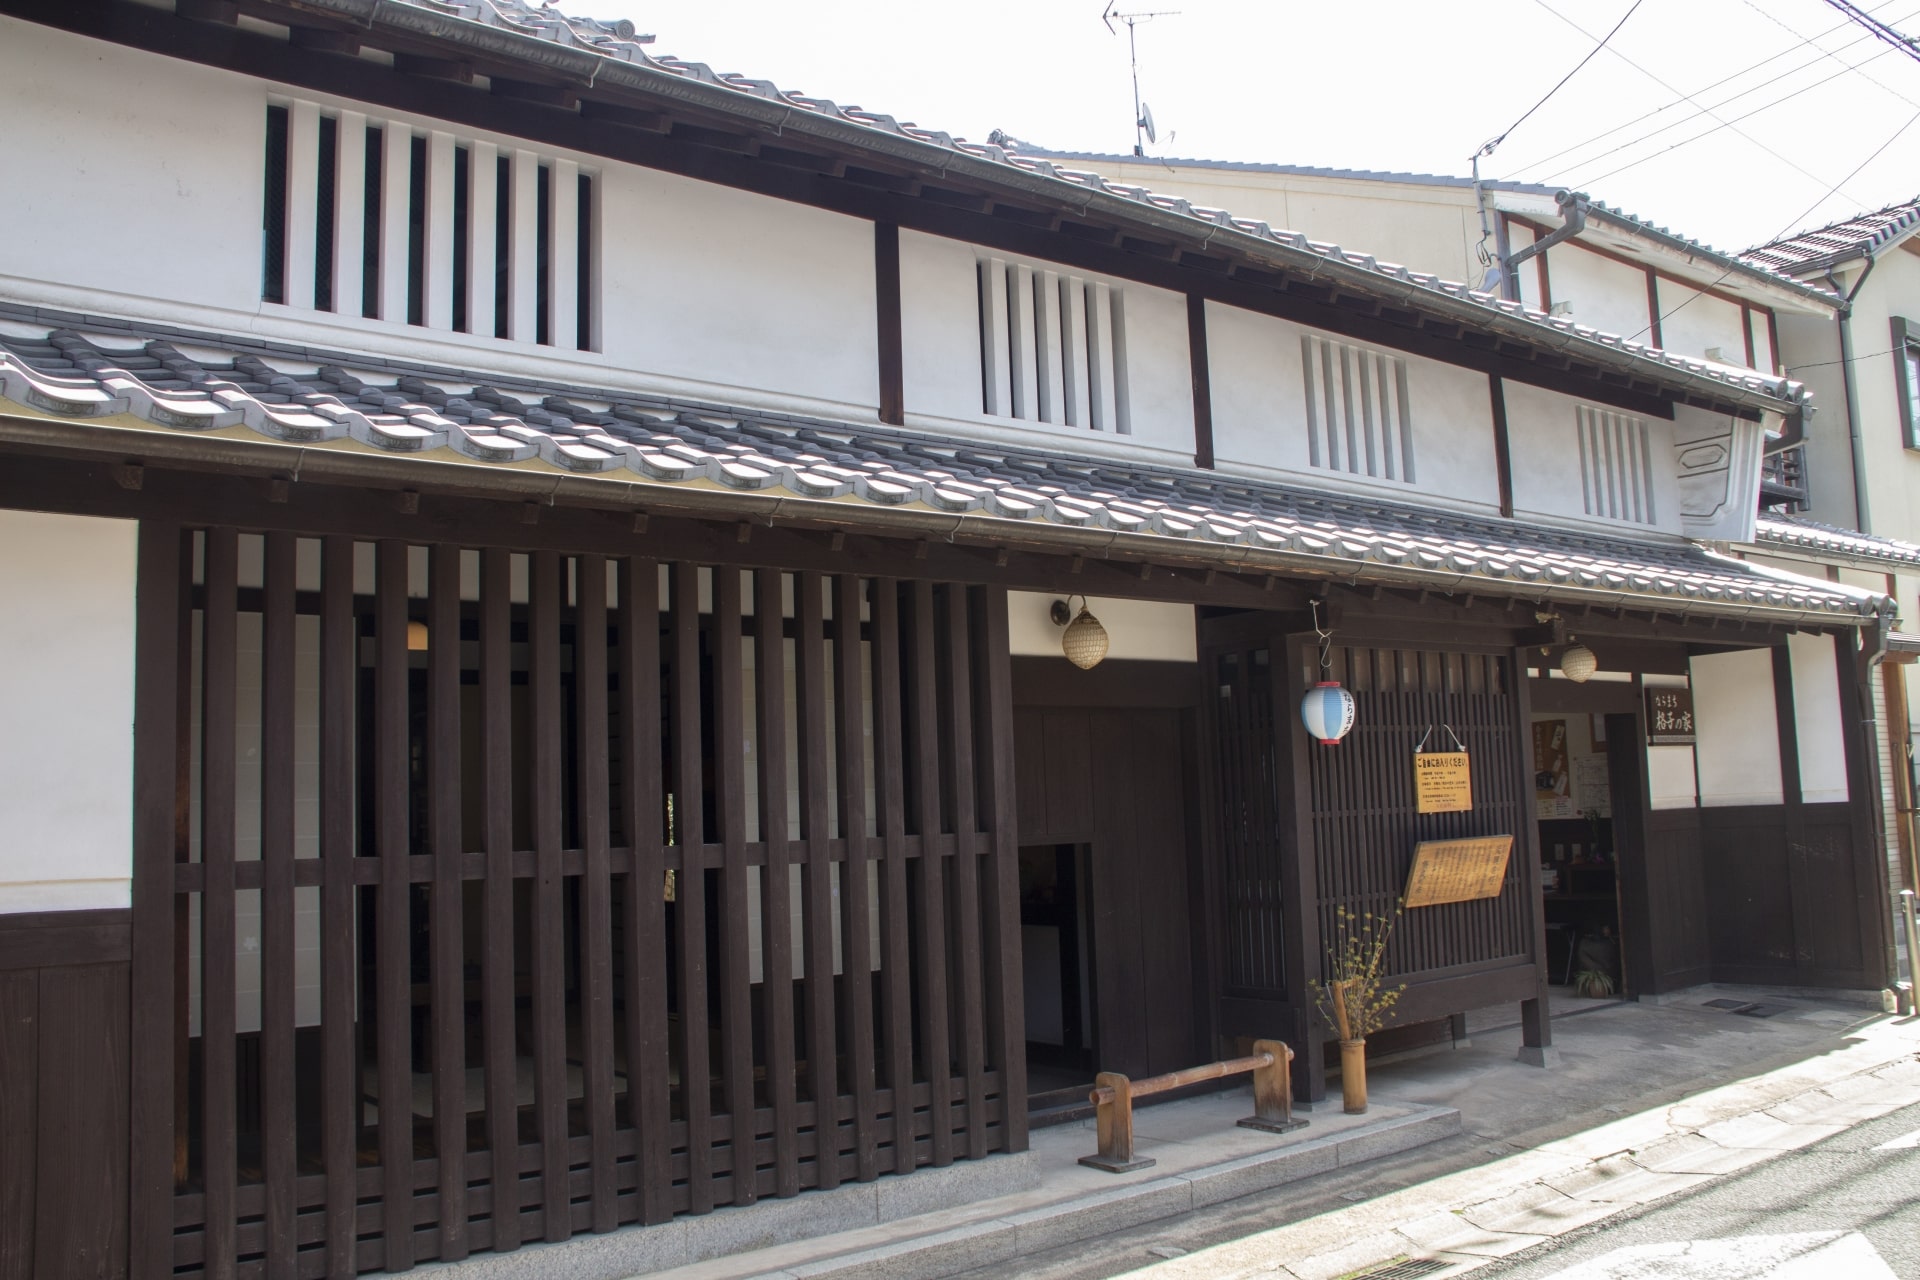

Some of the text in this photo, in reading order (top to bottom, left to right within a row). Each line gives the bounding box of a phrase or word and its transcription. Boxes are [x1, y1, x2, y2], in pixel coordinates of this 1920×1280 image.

[1655, 694, 1678, 708] ならまち
[1655, 709, 1692, 732] 格子の家
